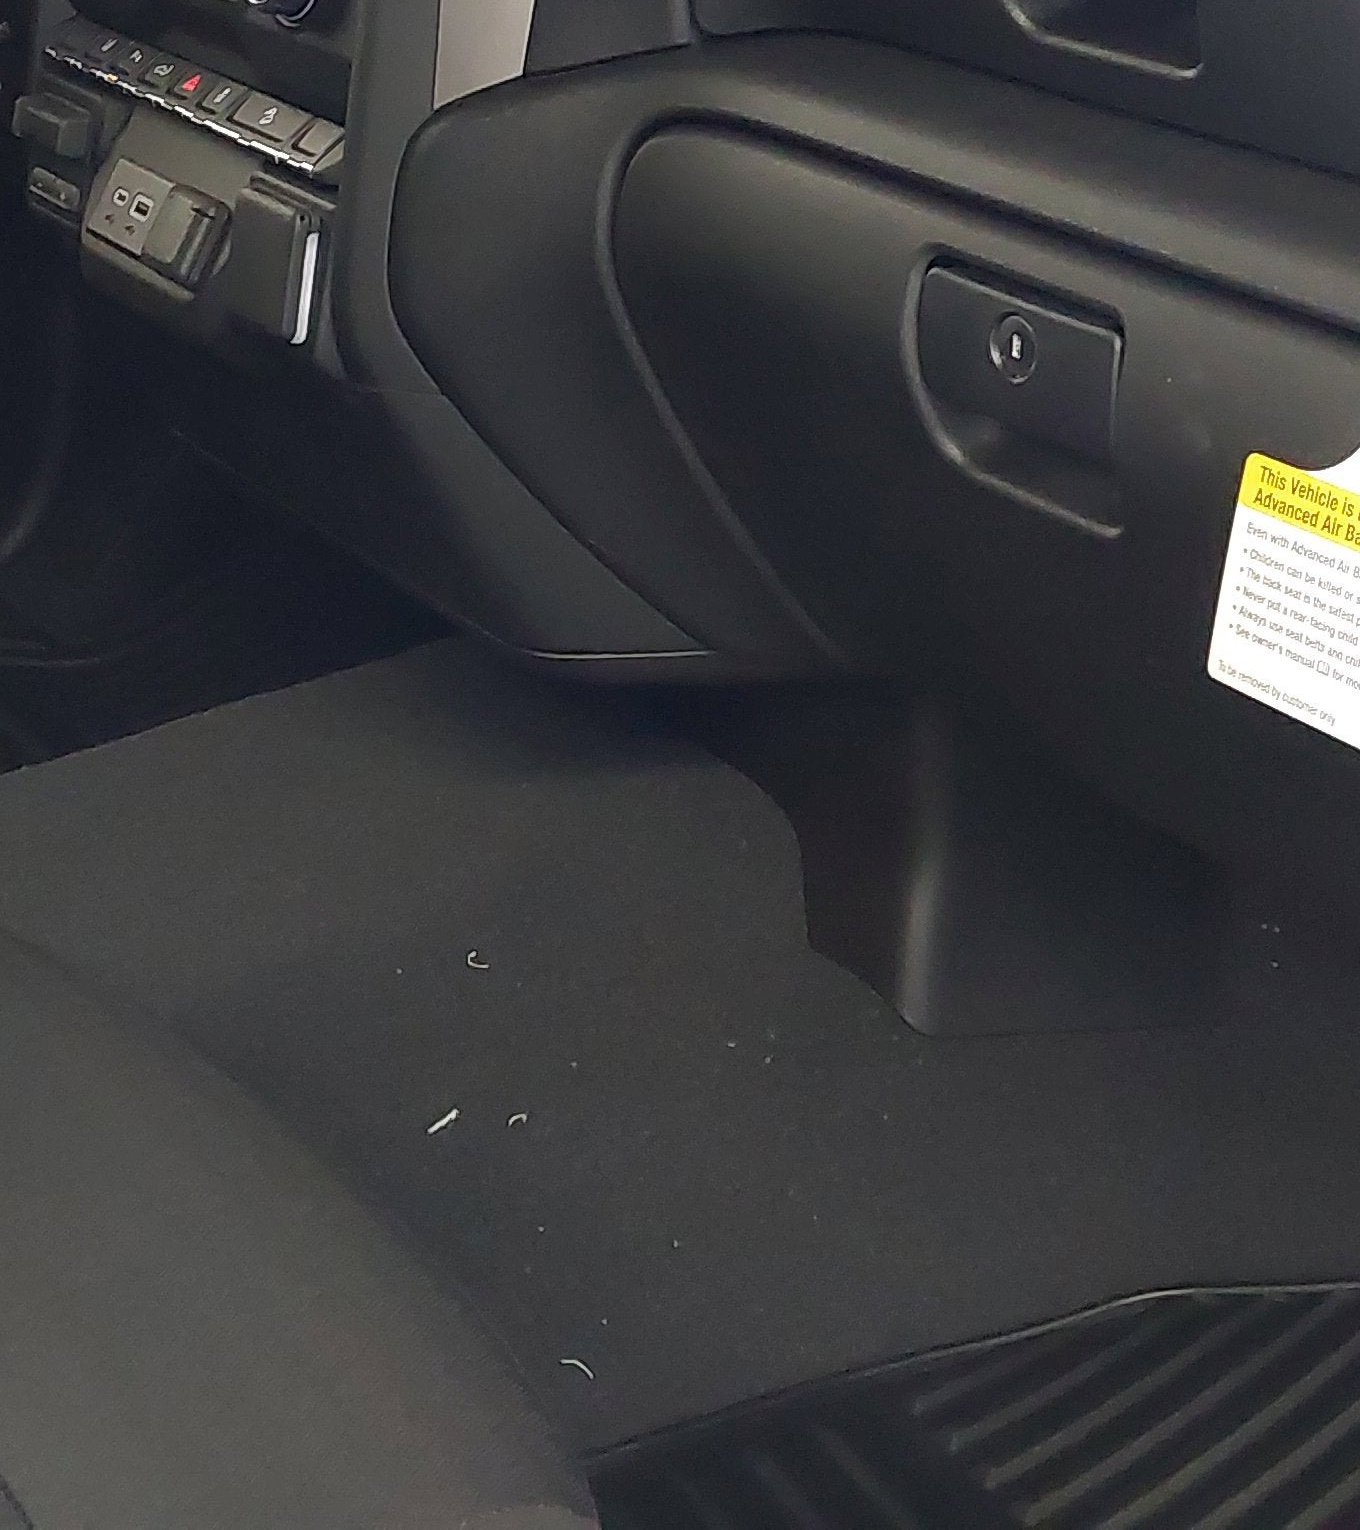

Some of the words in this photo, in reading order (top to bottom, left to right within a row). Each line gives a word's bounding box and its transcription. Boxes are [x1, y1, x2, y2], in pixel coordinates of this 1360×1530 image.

[1252, 487, 1320, 528] Advanced
[1320, 514, 1343, 536] Air
[1259, 465, 1287, 490] This
[1291, 476, 1338, 511] Vehicle
[1341, 496, 1354, 517] is
[1246, 521, 1267, 540] Even
[1270, 533, 1289, 548] with
[1290, 540, 1335, 568] Advanced
[1336, 559, 1350, 573] Air
[1246, 566, 1260, 582] The
[1283, 585, 1302, 600] seat
[1303, 593, 1310, 604] is
[1312, 596, 1326, 611] the
[1328, 605, 1354, 623] safest
[1249, 548, 1284, 572] Children
[1286, 566, 1302, 579] can
[1304, 571, 1315, 584] be
[1317, 576, 1342, 596] killed
[1343, 590, 1353, 601] or
[1266, 599, 1281, 612] put
[1289, 609, 1335, 638] rear-facing
[1337, 630, 1358, 646] child
[1285, 628, 1303, 643] seat
[1327, 647, 1343, 661] and
[1284, 648, 1315, 668] manual
[1332, 668, 1344, 681] for
